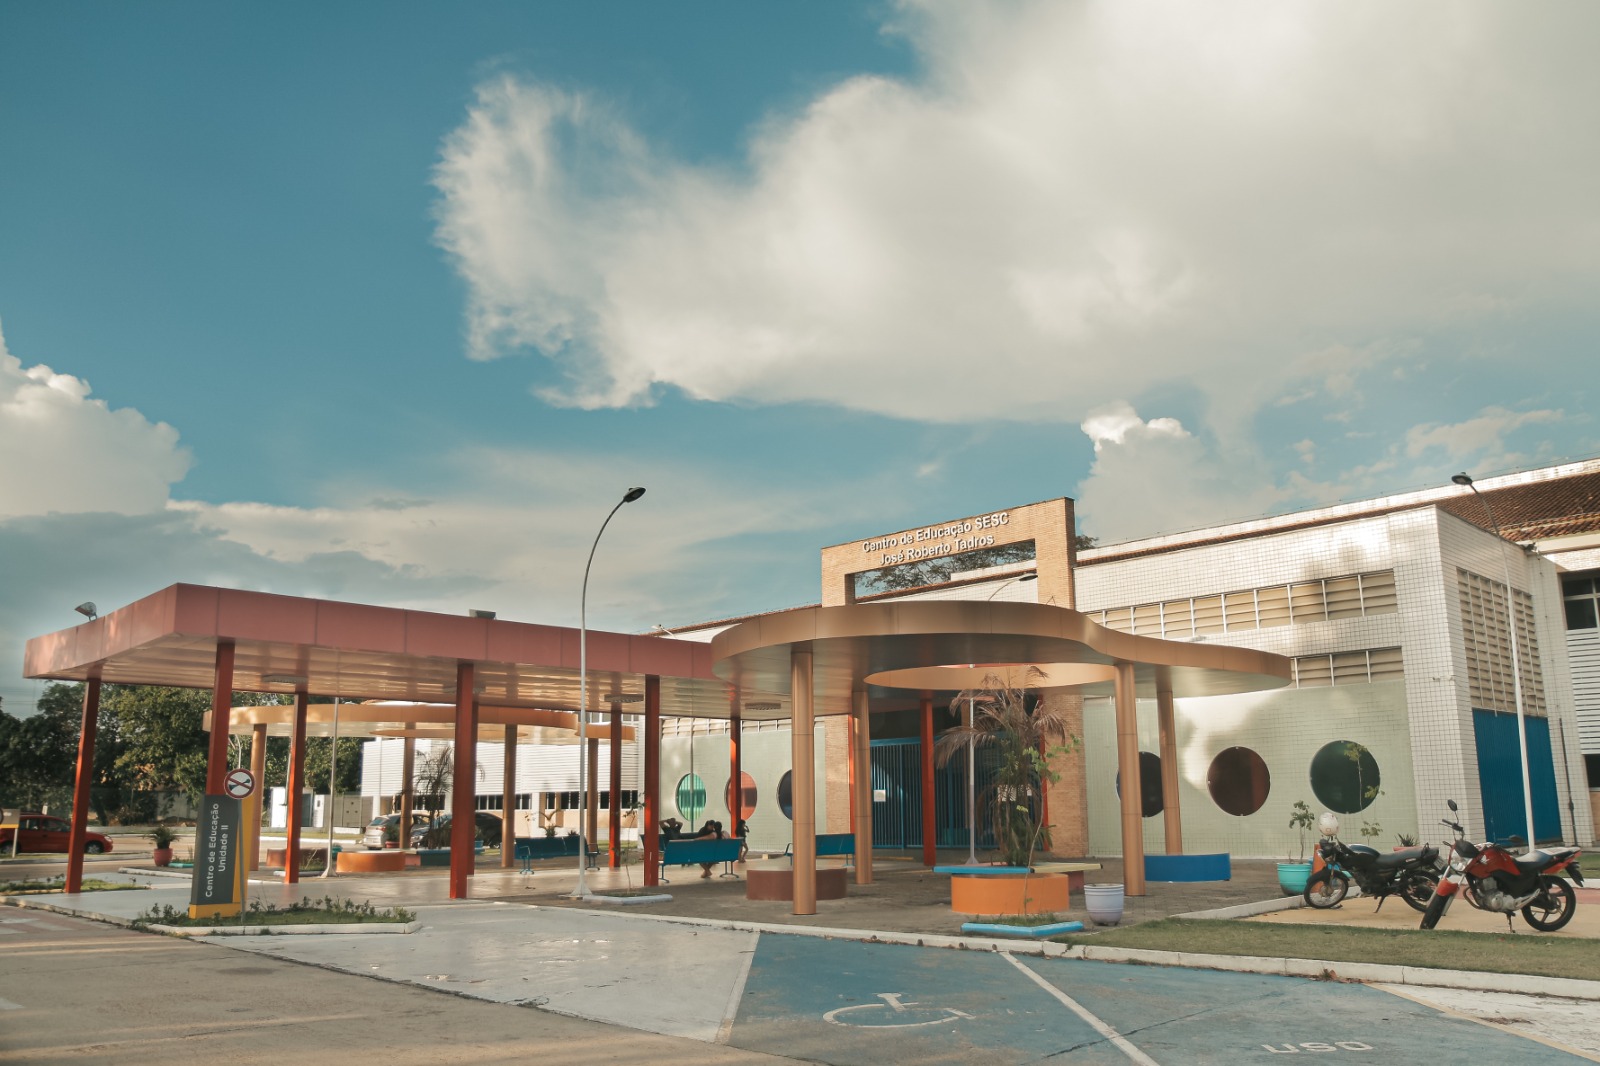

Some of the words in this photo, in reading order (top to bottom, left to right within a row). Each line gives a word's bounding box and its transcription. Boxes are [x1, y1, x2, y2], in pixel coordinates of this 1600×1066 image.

[863, 537, 897, 553] Centro
[900, 533, 914, 545] de
[916, 521, 972, 542] Educação
[975, 512, 1010, 530] SESC
[880, 551, 904, 566] José
[907, 542, 951, 560] Roberto
[954, 533, 994, 550] Tadros
[208, 803, 219, 848] Educação
[207, 851, 216, 863] de
[218, 833, 228, 872] Unidade
[205, 865, 215, 897] Centro
[1260, 1041, 1374, 1053] USO
